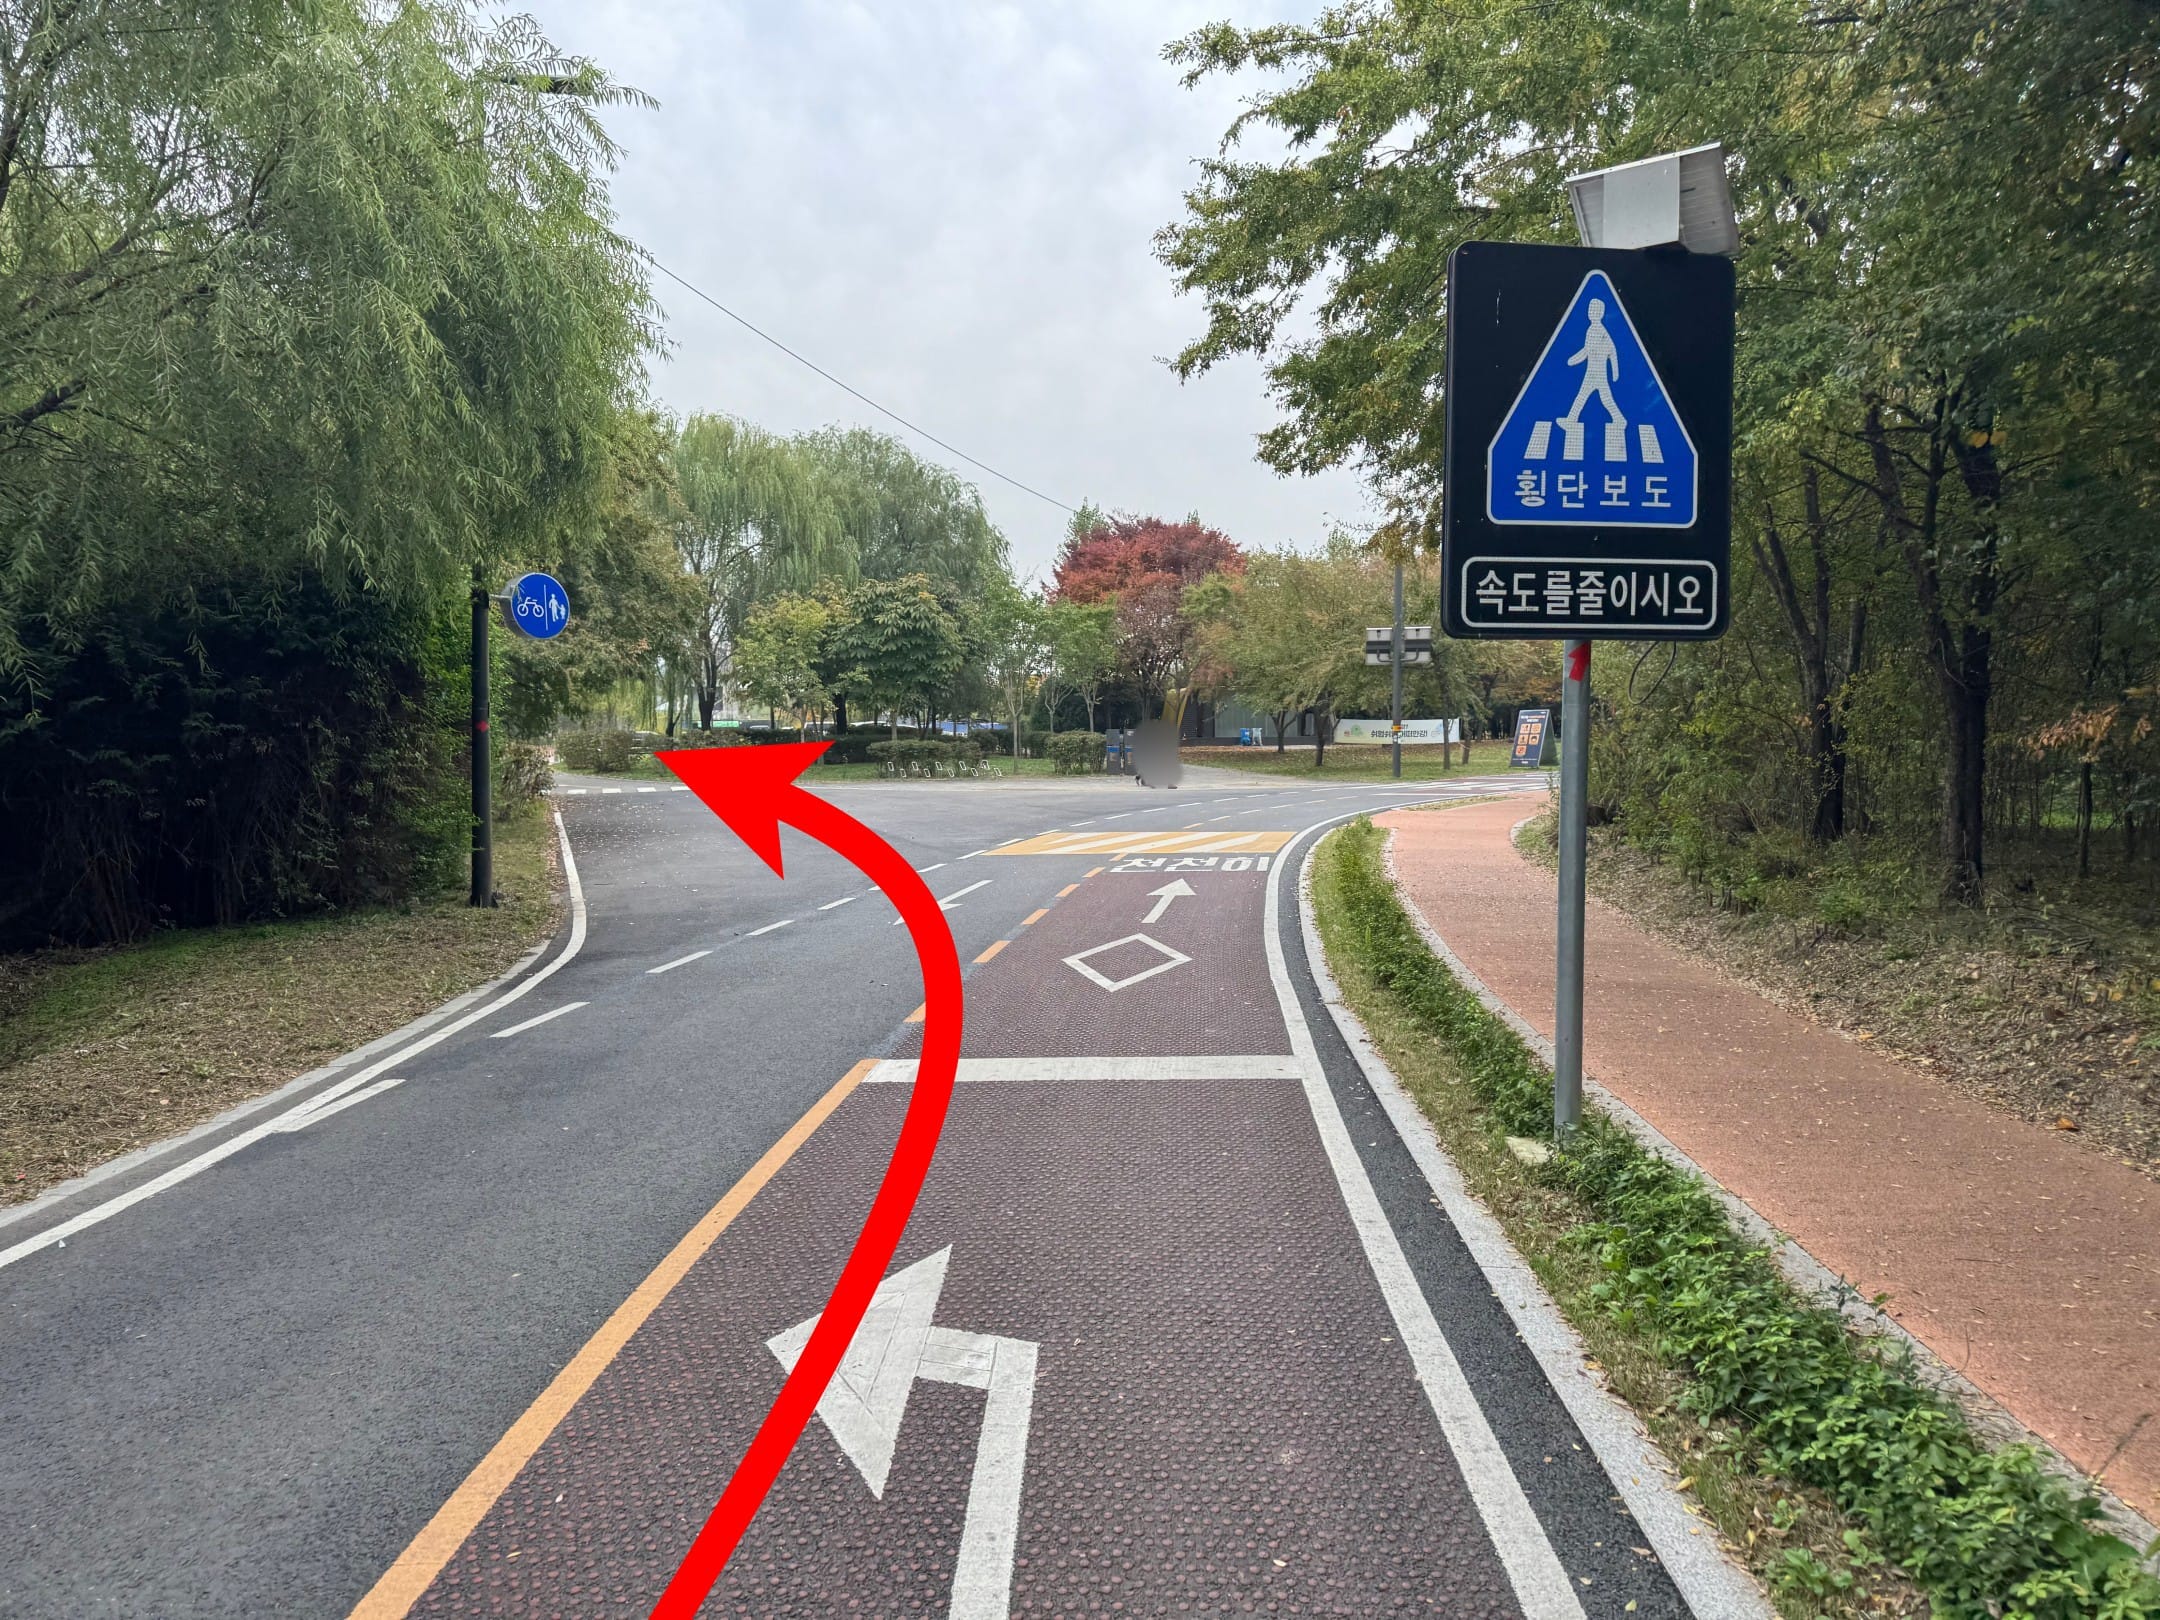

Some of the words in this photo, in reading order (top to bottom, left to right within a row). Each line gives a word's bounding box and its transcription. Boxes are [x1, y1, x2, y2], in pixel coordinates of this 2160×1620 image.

[1514, 469, 1672, 509] 횡단보도
[1475, 569, 1704, 617] 속도를줄이시오
[1109, 856, 1270, 873] 천천히
